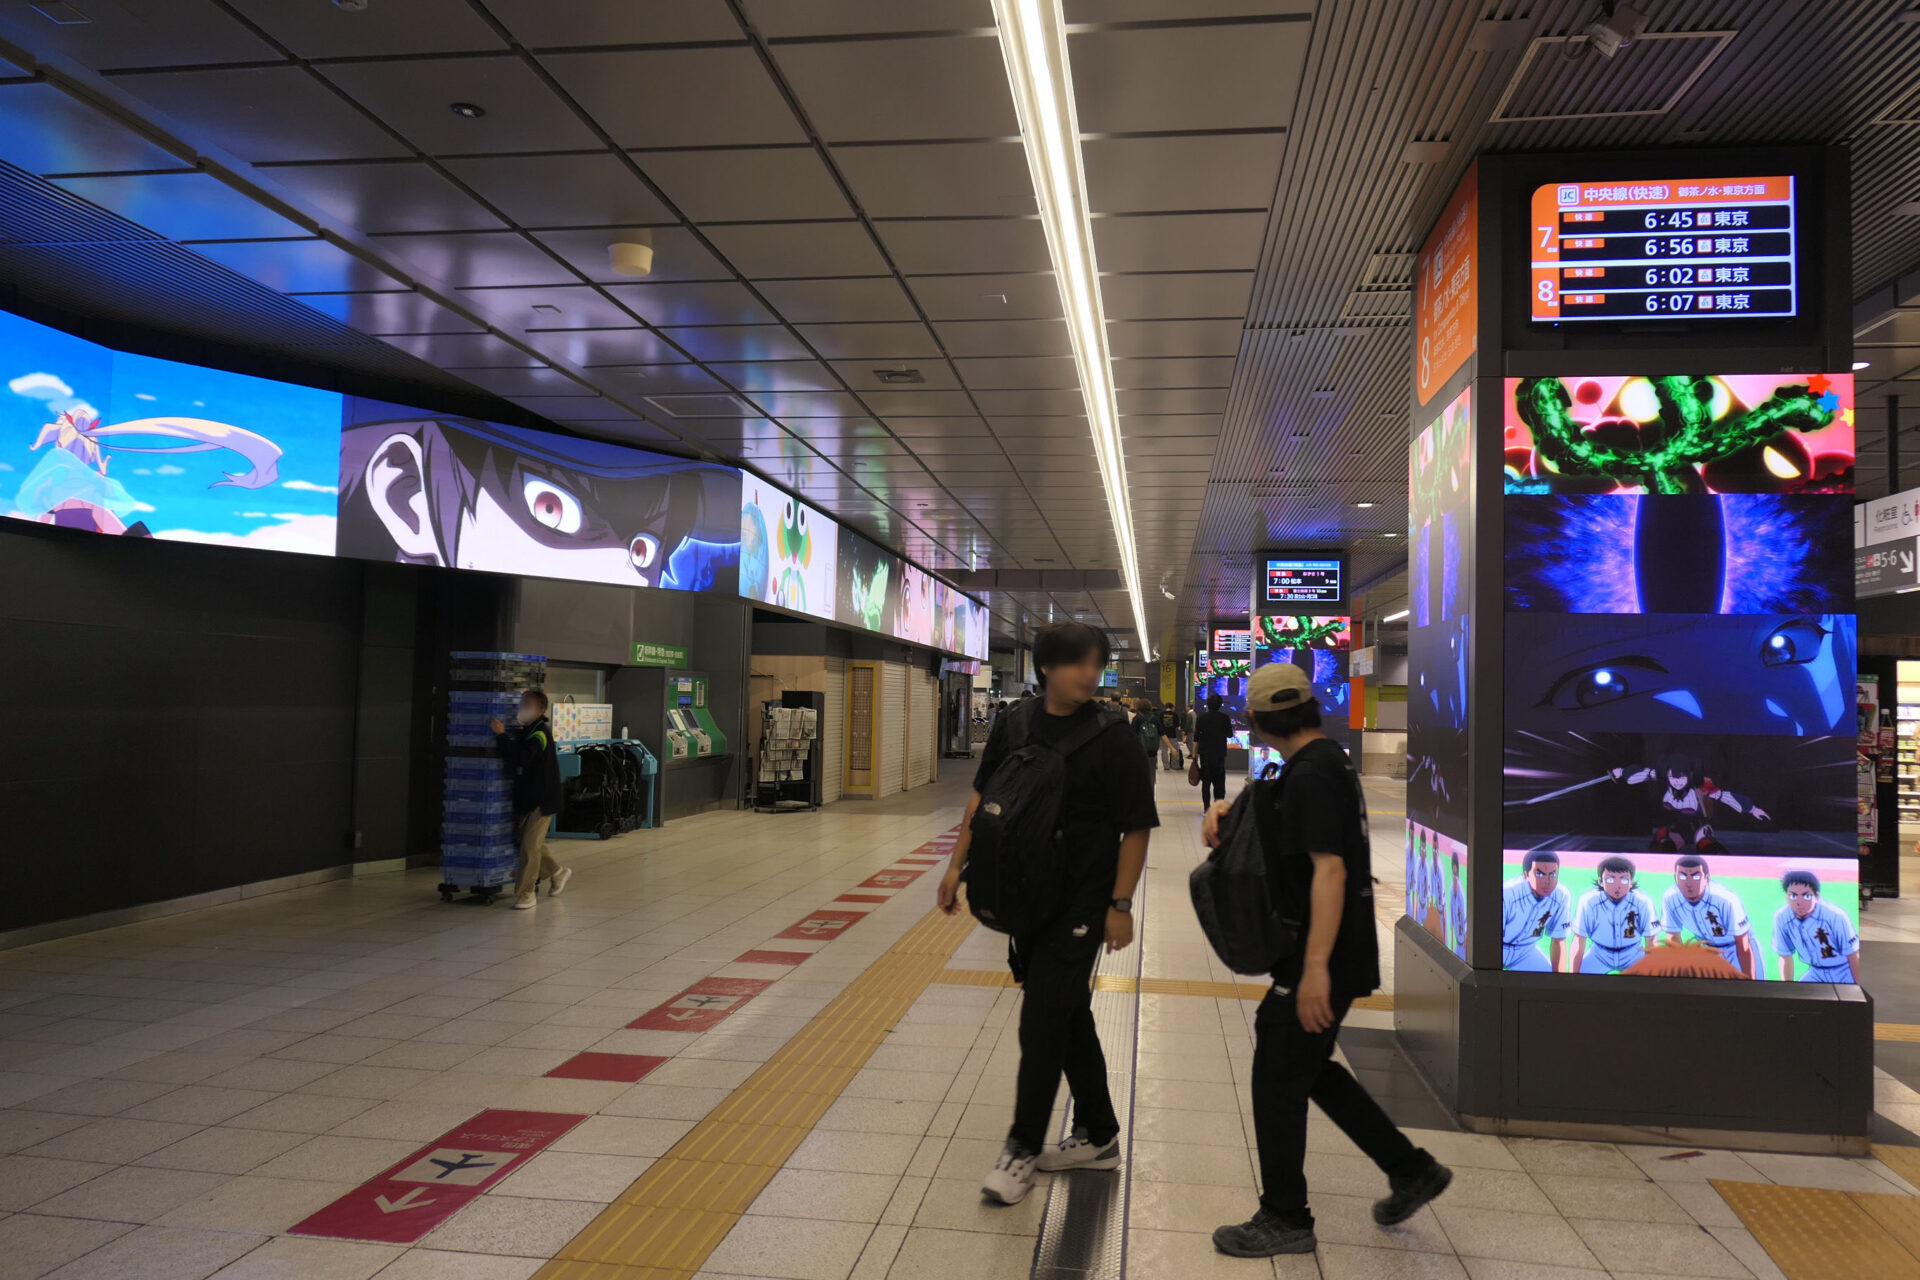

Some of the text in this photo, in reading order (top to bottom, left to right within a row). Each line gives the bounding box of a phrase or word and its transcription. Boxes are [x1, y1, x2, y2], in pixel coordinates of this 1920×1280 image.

[1563, 190, 1575, 200] JC
[1584, 185, 1670, 202] 中央線(快速)
[1644, 211, 1693, 229] 6:45
[1714, 210, 1749, 226] 東京
[1537, 226, 1554, 248] 7
[1714, 237, 1749, 253] 東京
[1645, 238, 1694, 256] 6:56
[1645, 268, 1694, 285] 6:02
[1715, 267, 1750, 283] 東京
[1537, 280, 1554, 301] 8
[1646, 295, 1694, 312] 6:07
[1715, 294, 1750, 310] 東京
